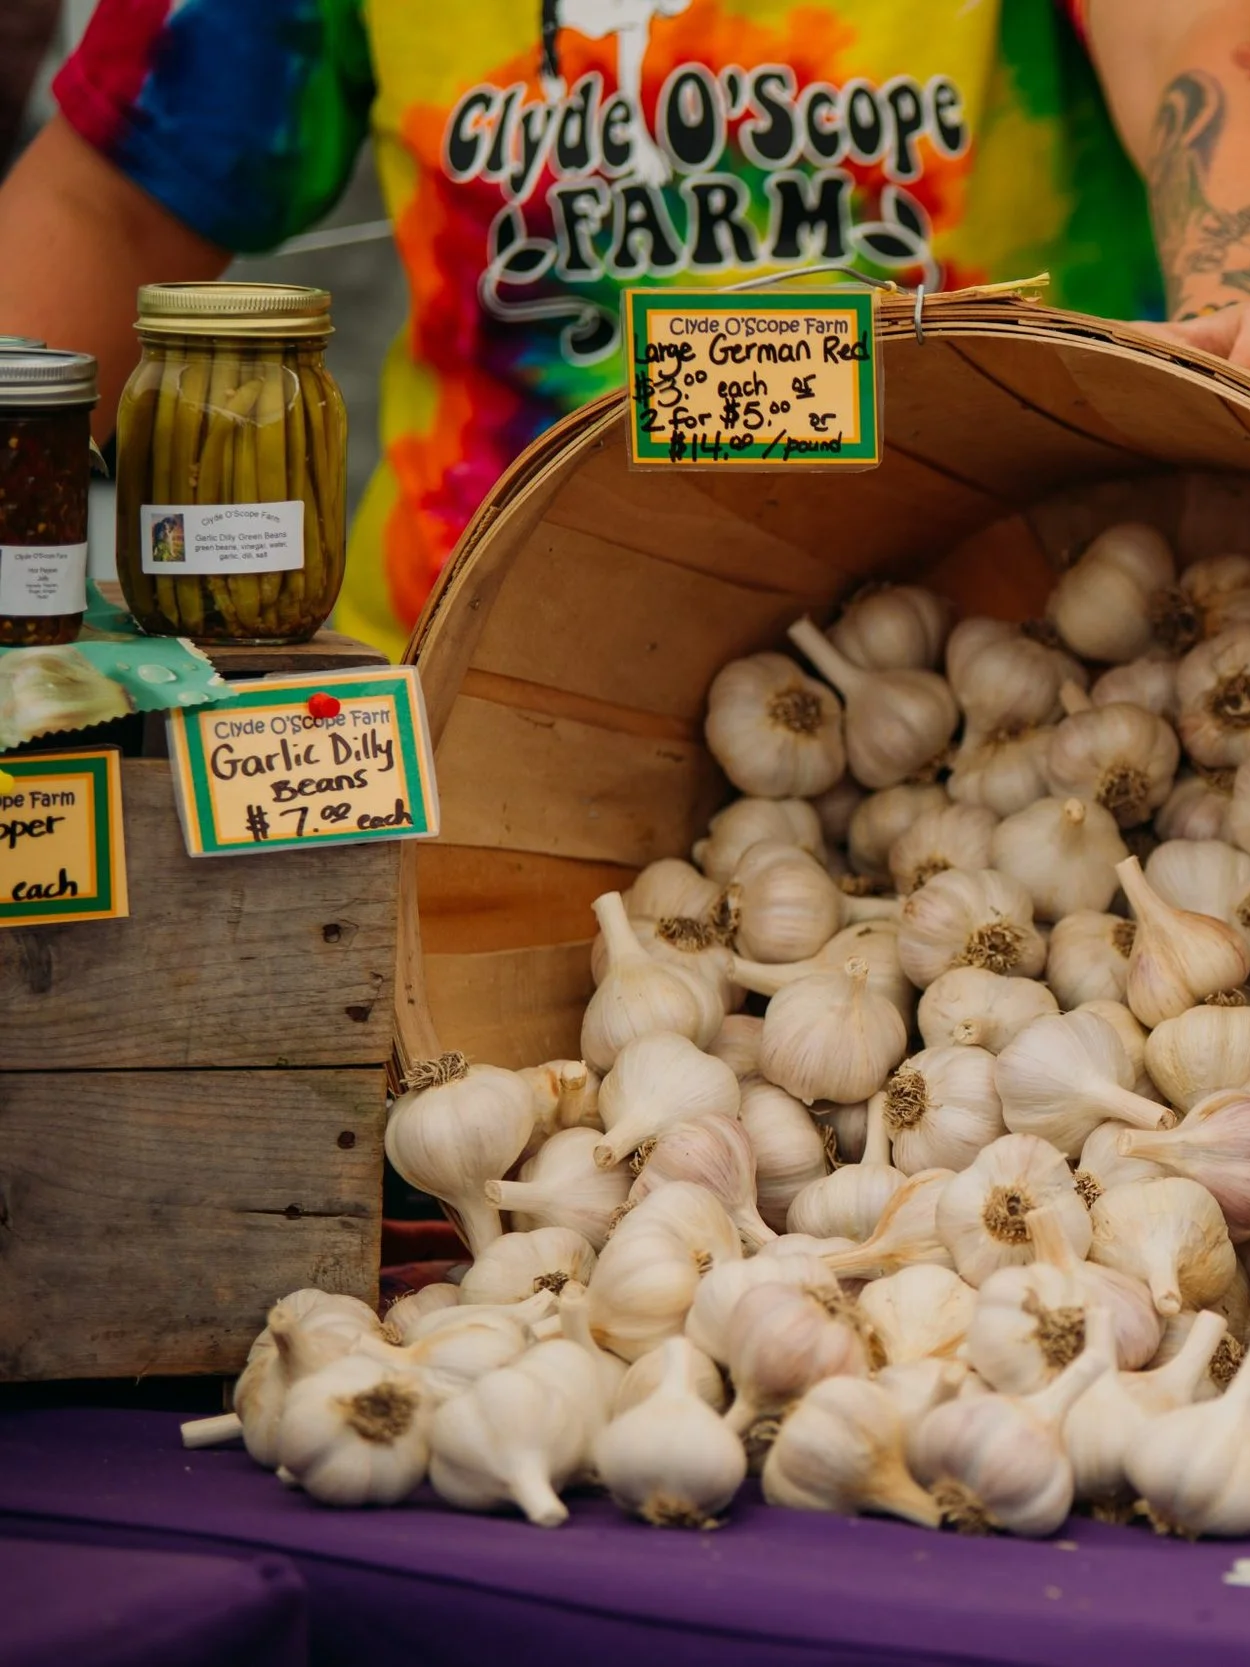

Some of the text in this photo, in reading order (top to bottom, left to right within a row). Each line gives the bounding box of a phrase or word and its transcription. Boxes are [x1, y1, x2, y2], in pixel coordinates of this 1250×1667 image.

[444, 72, 640, 200] Clyde
[551, 170, 852, 276] FARM
[669, 317, 848, 337] Clyde O'Scope Farm
[634, 331, 871, 380] Large German Red
[717, 371, 768, 398] each
[792, 374, 816, 399] or
[640, 407, 665, 433] 2
[669, 406, 712, 429] for
[809, 412, 836, 432] or
[201, 513, 224, 527] Clyde
[260, 511, 281, 523] Farm
[194, 544, 214, 553] green
[195, 531, 288, 542] Garlic Dilly Green Beans
[214, 719, 265, 740] Clyde
[211, 728, 394, 780] Garlic Dilly
[272, 768, 368, 803] Beans
[0, 791, 75, 811] pe Farm
[357, 798, 414, 830] each
[12, 868, 78, 901] each
